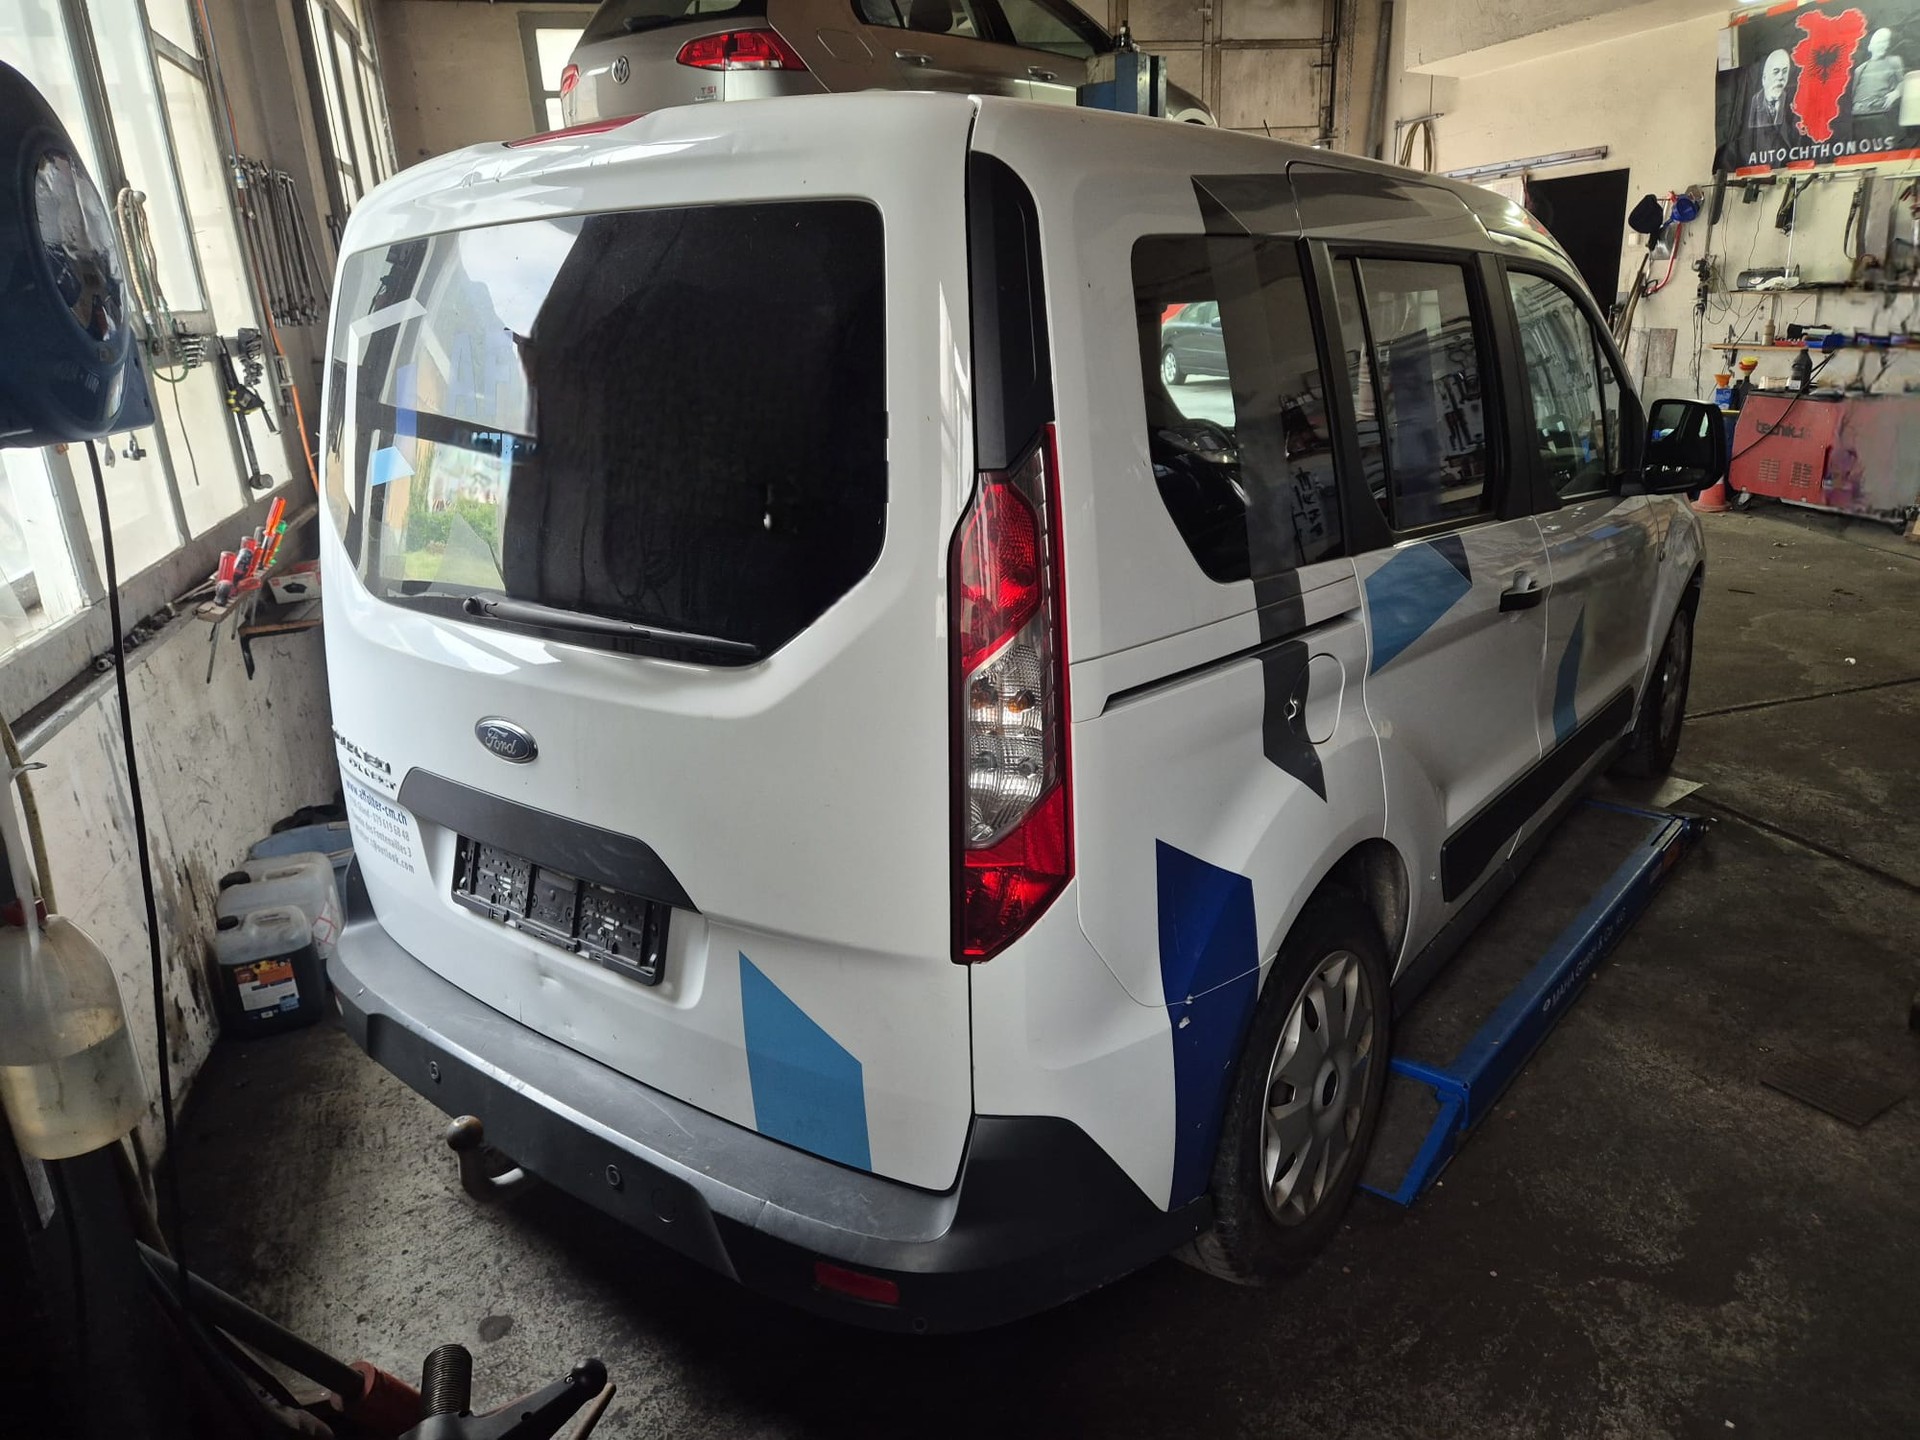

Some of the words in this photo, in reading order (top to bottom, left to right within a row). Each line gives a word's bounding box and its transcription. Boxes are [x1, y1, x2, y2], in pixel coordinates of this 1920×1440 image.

[700, 86, 717, 95] TSI
[1748, 136, 1896, 165] AUTOCHTHONOUS
[485, 727, 517, 755] Ford
